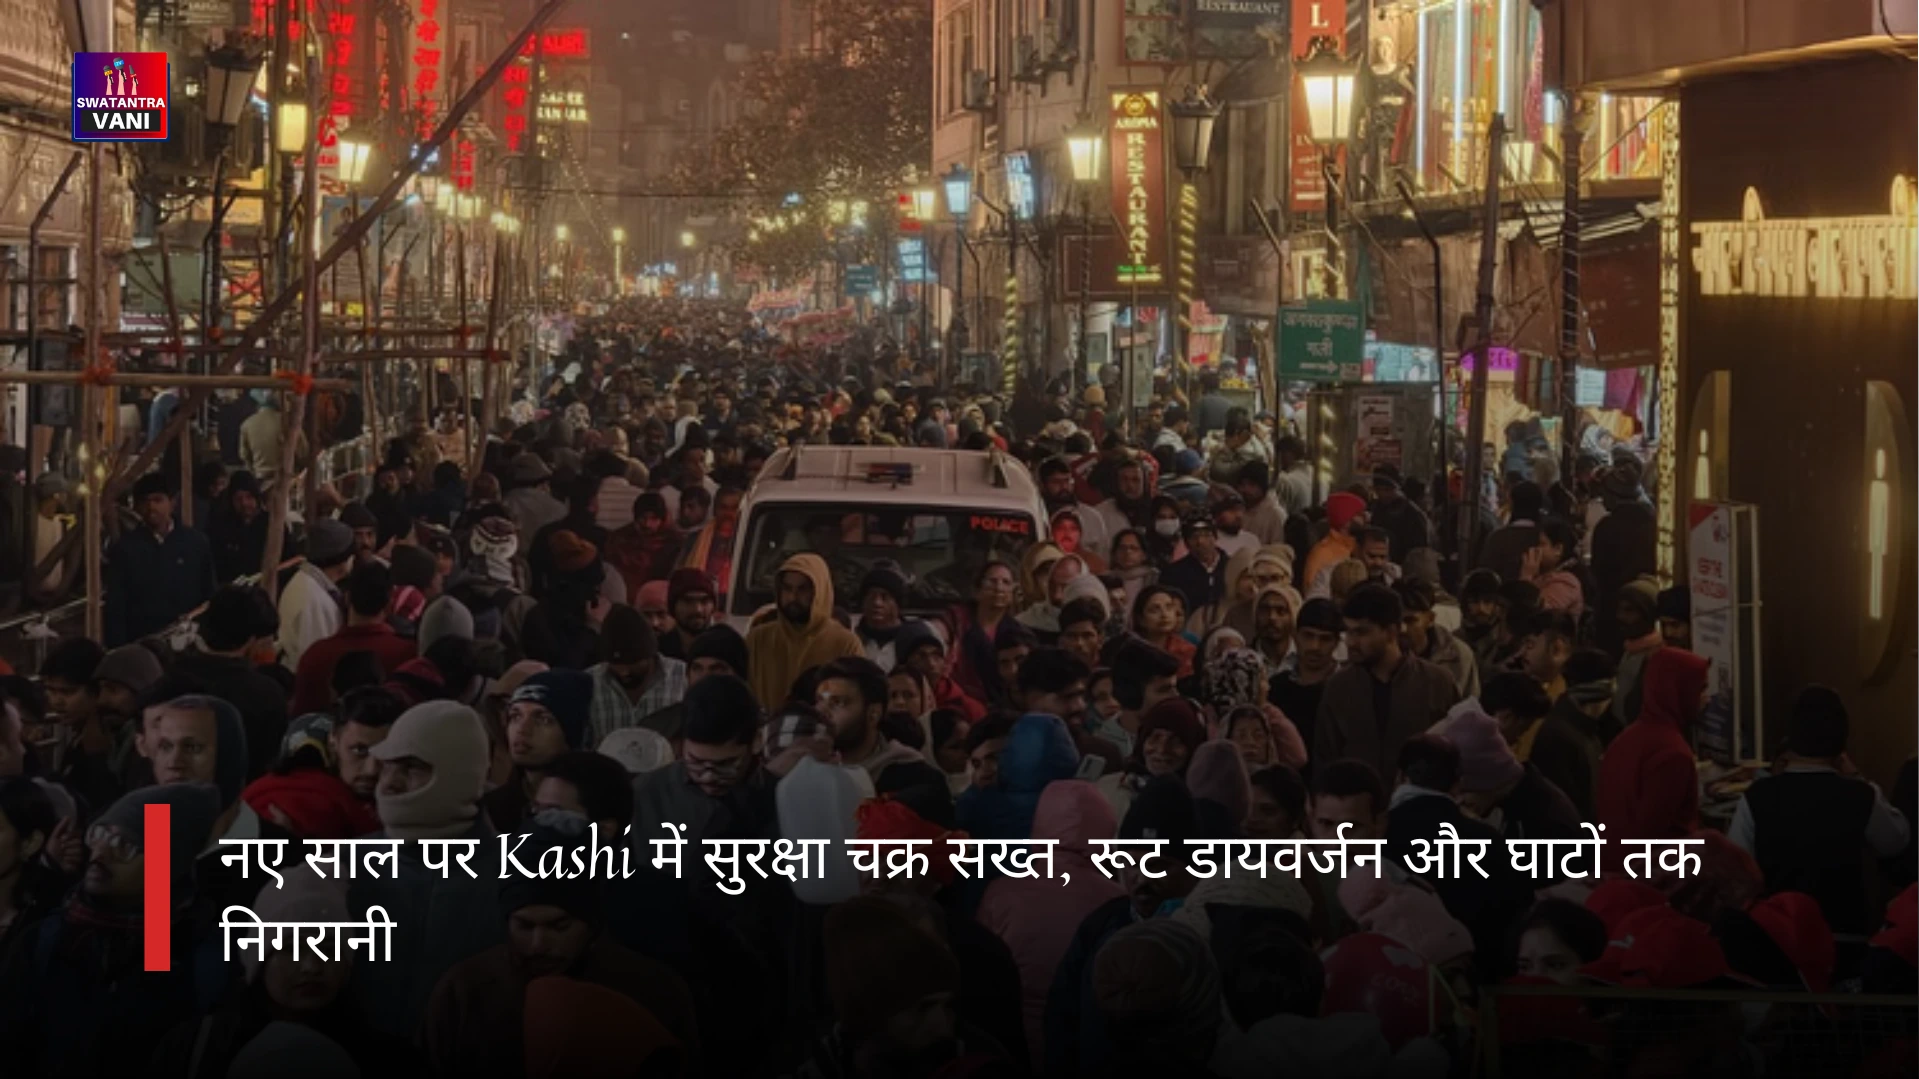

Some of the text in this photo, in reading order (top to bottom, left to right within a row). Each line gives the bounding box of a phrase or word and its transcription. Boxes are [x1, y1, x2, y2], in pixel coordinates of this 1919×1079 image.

[1115, 117, 1158, 128] AROMA
[1127, 132, 1148, 264] RESTAURANT
[970, 515, 1029, 534] POLICE
